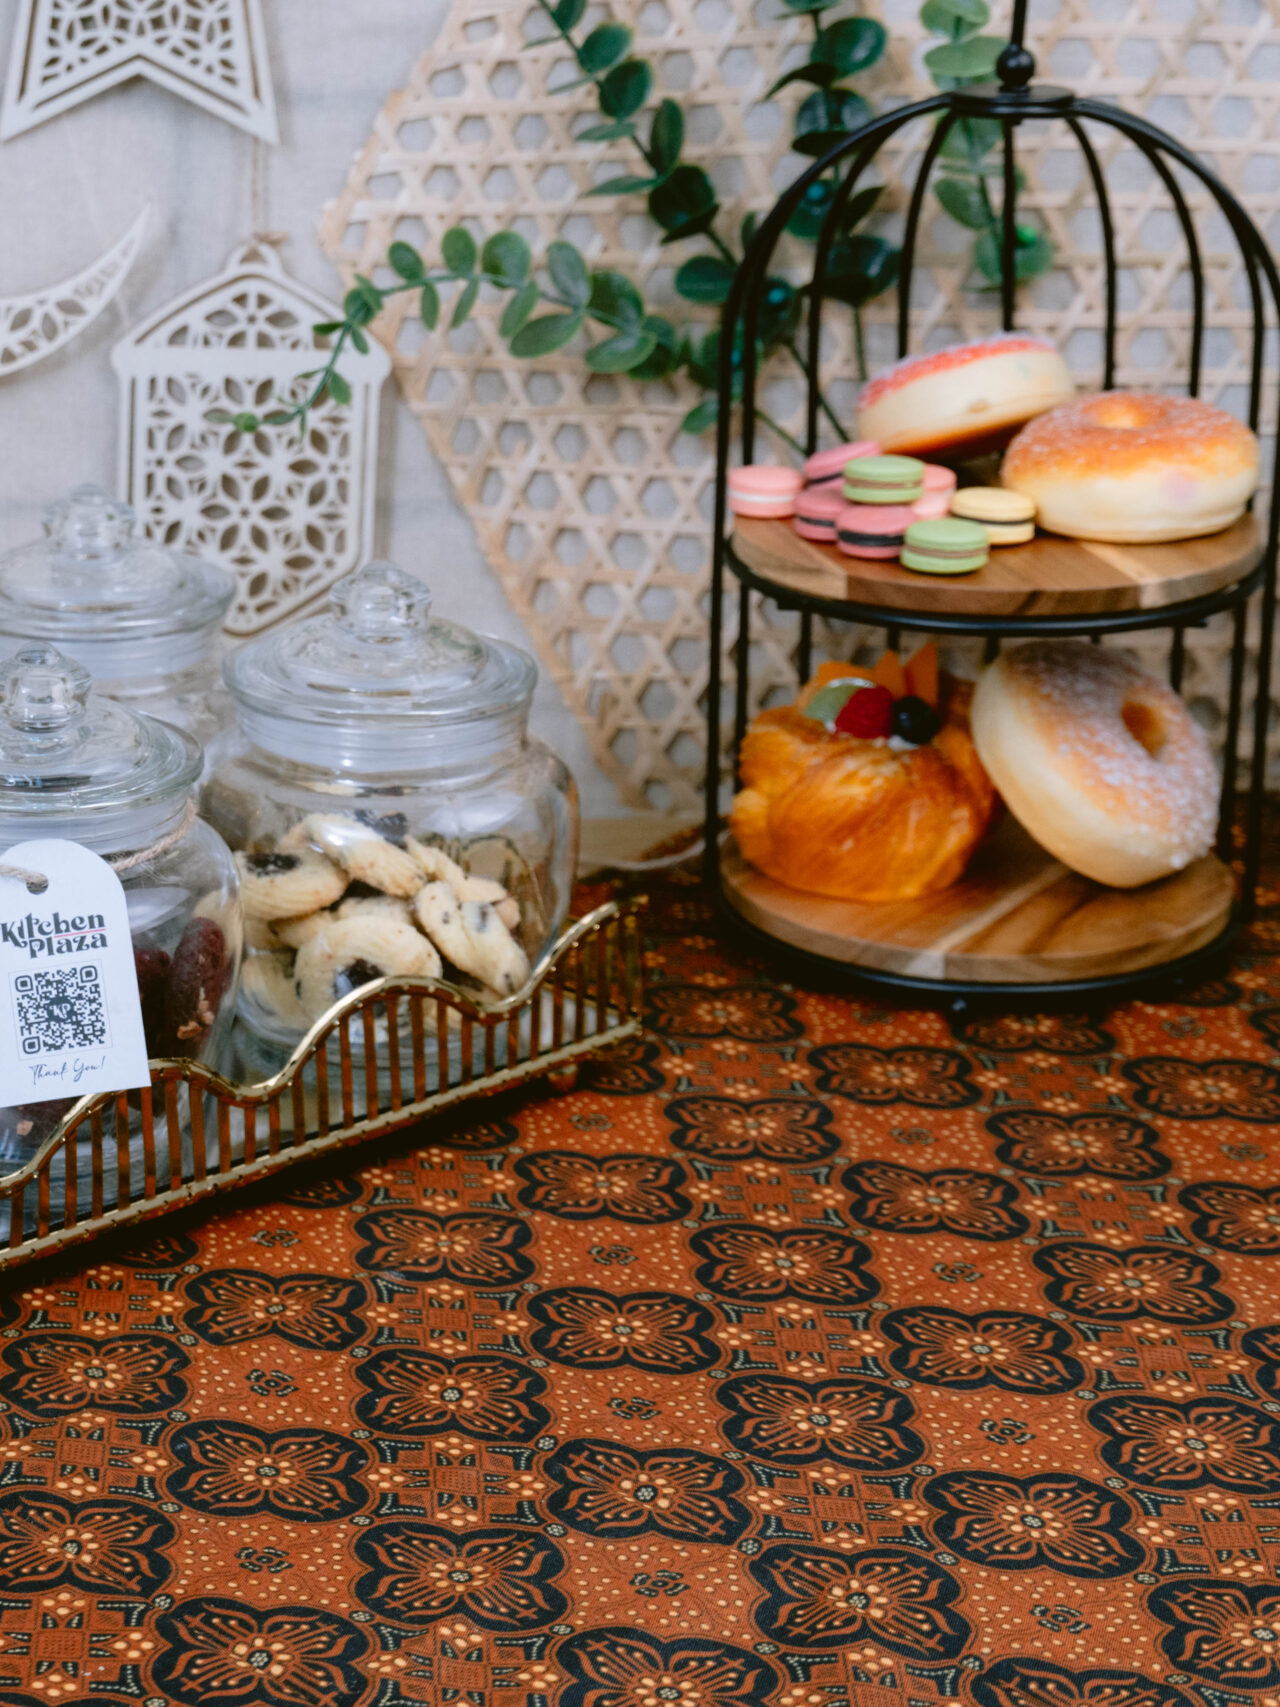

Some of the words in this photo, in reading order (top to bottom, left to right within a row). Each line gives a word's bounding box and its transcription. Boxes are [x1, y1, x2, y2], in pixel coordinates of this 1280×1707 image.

[29, 932, 108, 959] Plaza
[49, 1003, 71, 1019] KP
[29, 1062, 68, 1085] Thank
[73, 1056, 106, 1082] You!
